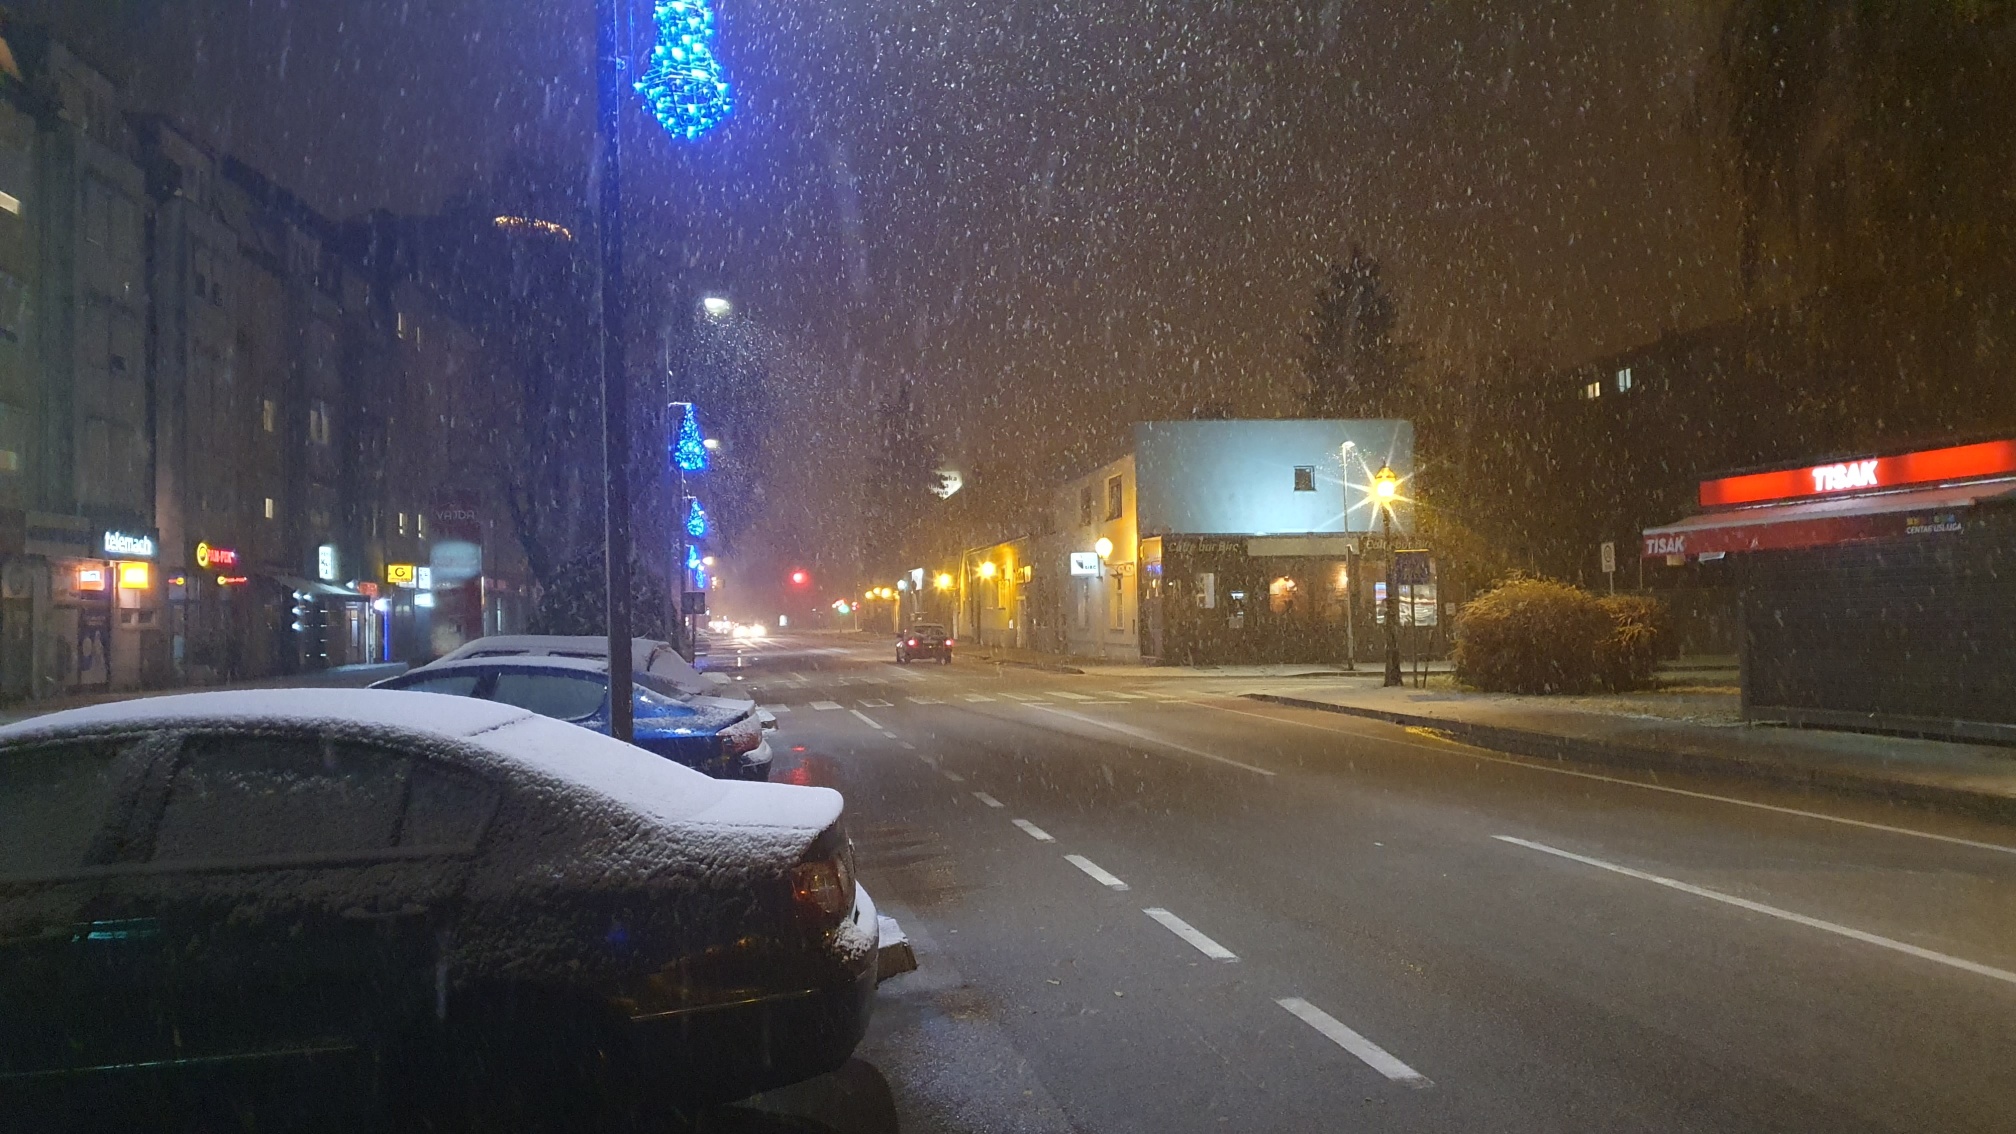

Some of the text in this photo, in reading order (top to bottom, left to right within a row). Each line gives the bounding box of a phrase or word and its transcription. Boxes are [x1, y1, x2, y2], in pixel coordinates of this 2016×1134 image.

[1811, 460, 1879, 491] TISAK
[104, 532, 153, 554] telemach
[1645, 535, 1684, 554] TISAK
